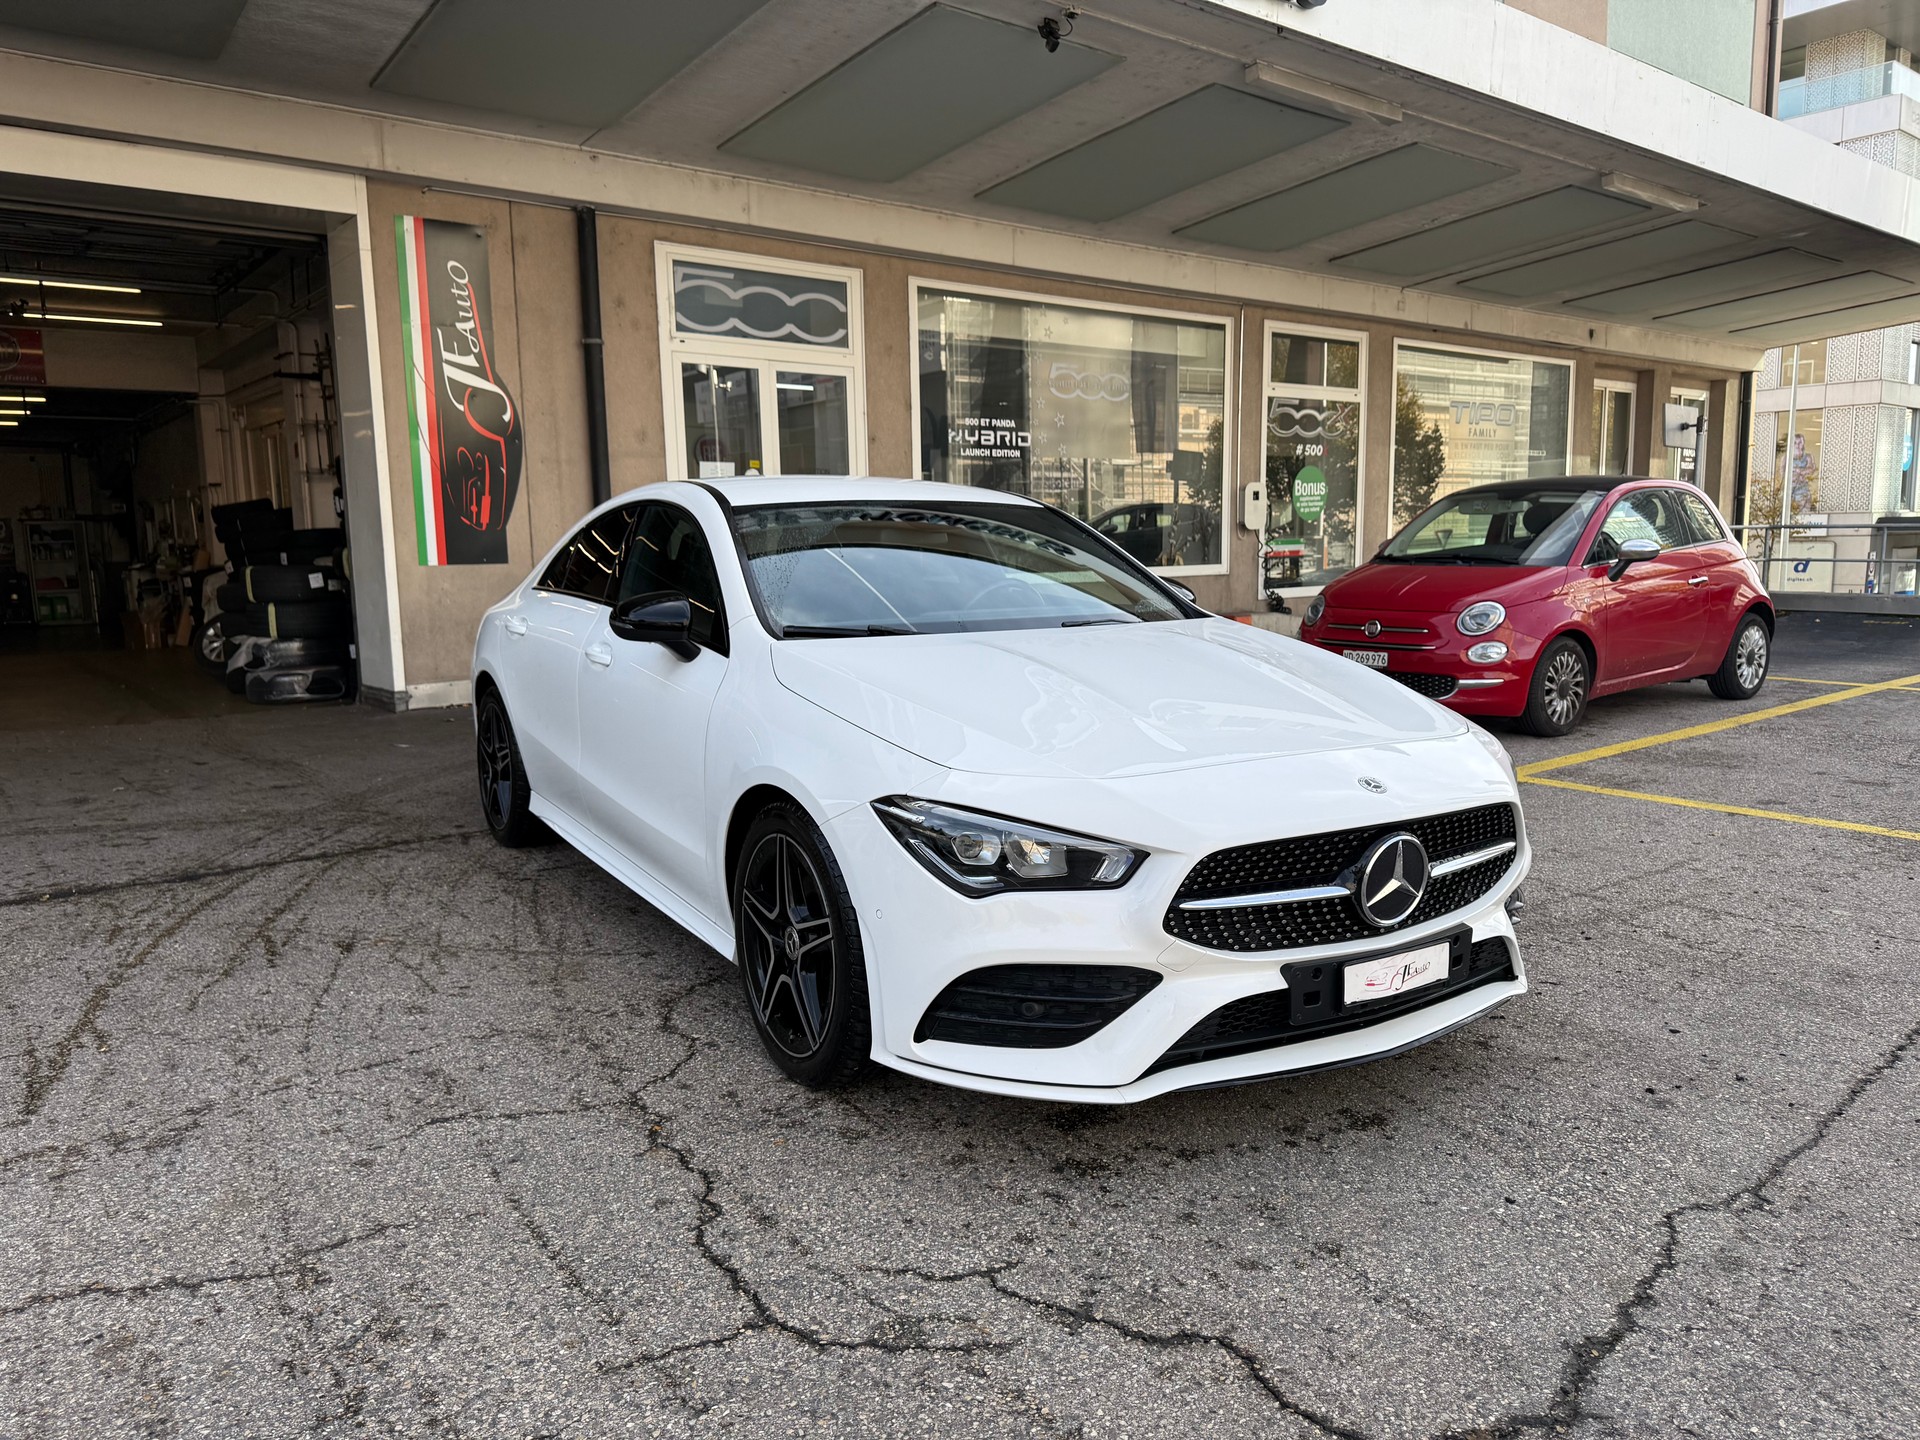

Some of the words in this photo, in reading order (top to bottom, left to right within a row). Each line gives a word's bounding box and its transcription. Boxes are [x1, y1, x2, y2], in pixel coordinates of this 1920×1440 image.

[674, 266, 847, 344] 500
[1048, 362, 1130, 402] 500
[1450, 400, 1516, 427] TIPO
[964, 417, 979, 426] 500
[980, 418, 990, 427] ET
[991, 418, 1016, 428] PANDA
[948, 428, 1032, 447] HYBRID
[1468, 427, 1497, 438] FAMILY
[960, 447, 990, 457] LAUNCH
[991, 449, 1021, 458] EDITION
[1294, 479, 1326, 496] Bonus
[1355, 653, 1370, 664] 269
[1371, 653, 1387, 665] 976
